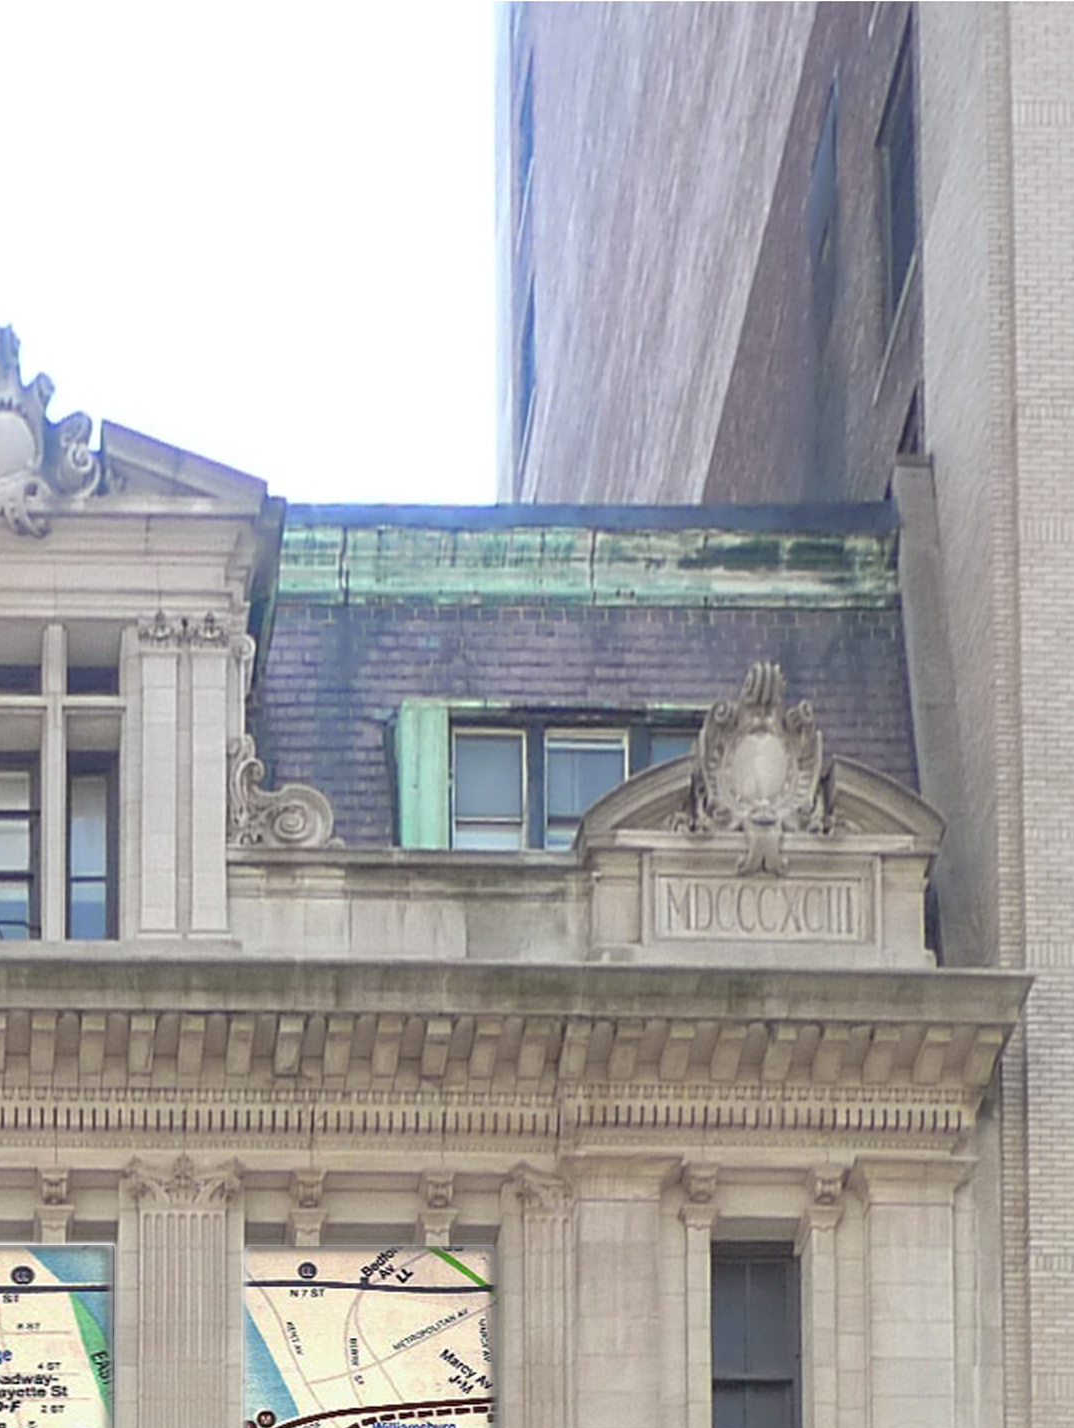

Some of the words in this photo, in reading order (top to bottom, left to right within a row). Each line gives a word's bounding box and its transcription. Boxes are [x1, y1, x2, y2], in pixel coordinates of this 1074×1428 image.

[666, 882, 854, 934] MDCCCXCIII
[440, 1349, 476, 1381] Marcy
[51, 1386, 68, 1397] St
